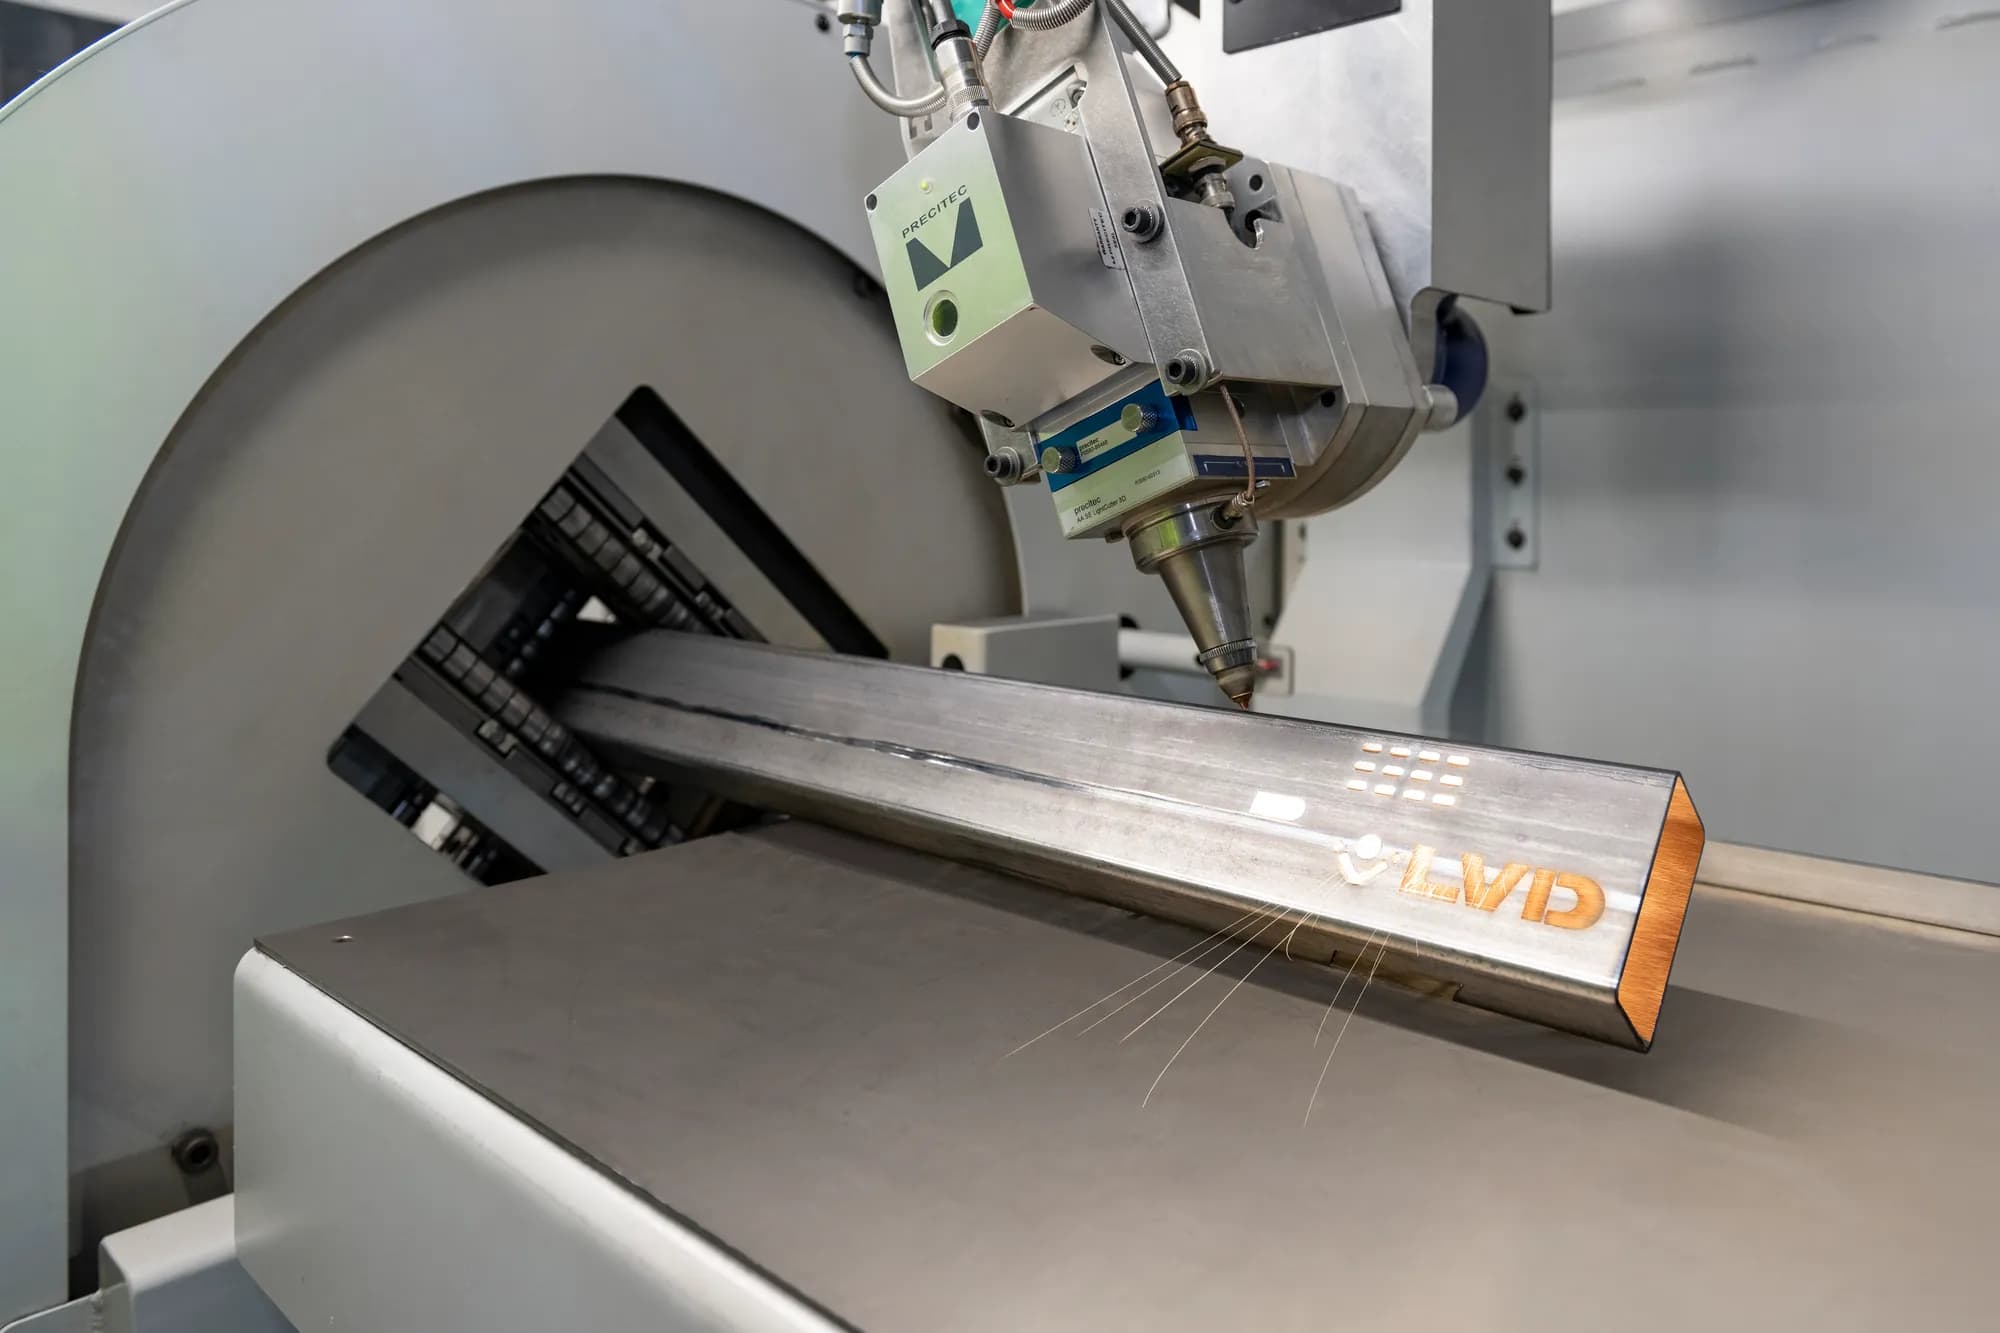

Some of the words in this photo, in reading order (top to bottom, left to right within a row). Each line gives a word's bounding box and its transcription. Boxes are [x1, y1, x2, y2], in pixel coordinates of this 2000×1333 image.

[902, 184, 967, 238] PRECITEC
[1074, 496, 1101, 516] precitec
[1399, 844, 1606, 930] LVD
